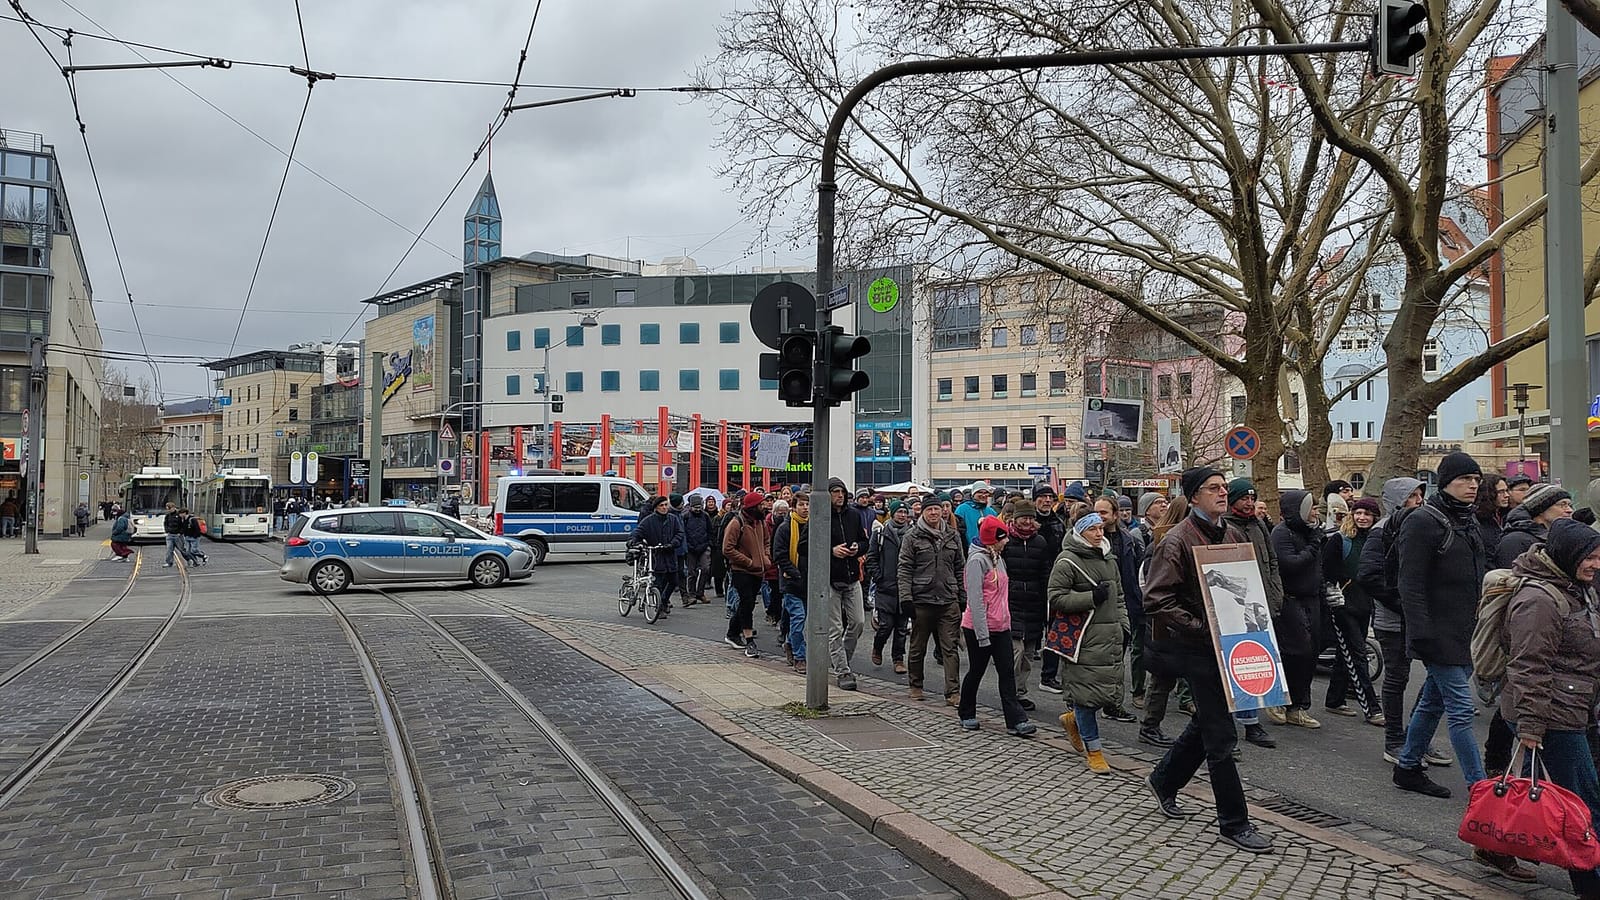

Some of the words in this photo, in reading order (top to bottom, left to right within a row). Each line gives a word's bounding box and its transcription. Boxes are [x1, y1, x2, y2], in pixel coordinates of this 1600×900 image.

[968, 463, 990, 471] THE
[994, 463, 1025, 471] BEAN
[422, 545, 461, 555] POLIZEI
[1232, 654, 1269, 664] FASCHISMUS
[1236, 671, 1273, 681] VERBRECHEN
[1467, 819, 1528, 846] adidas
